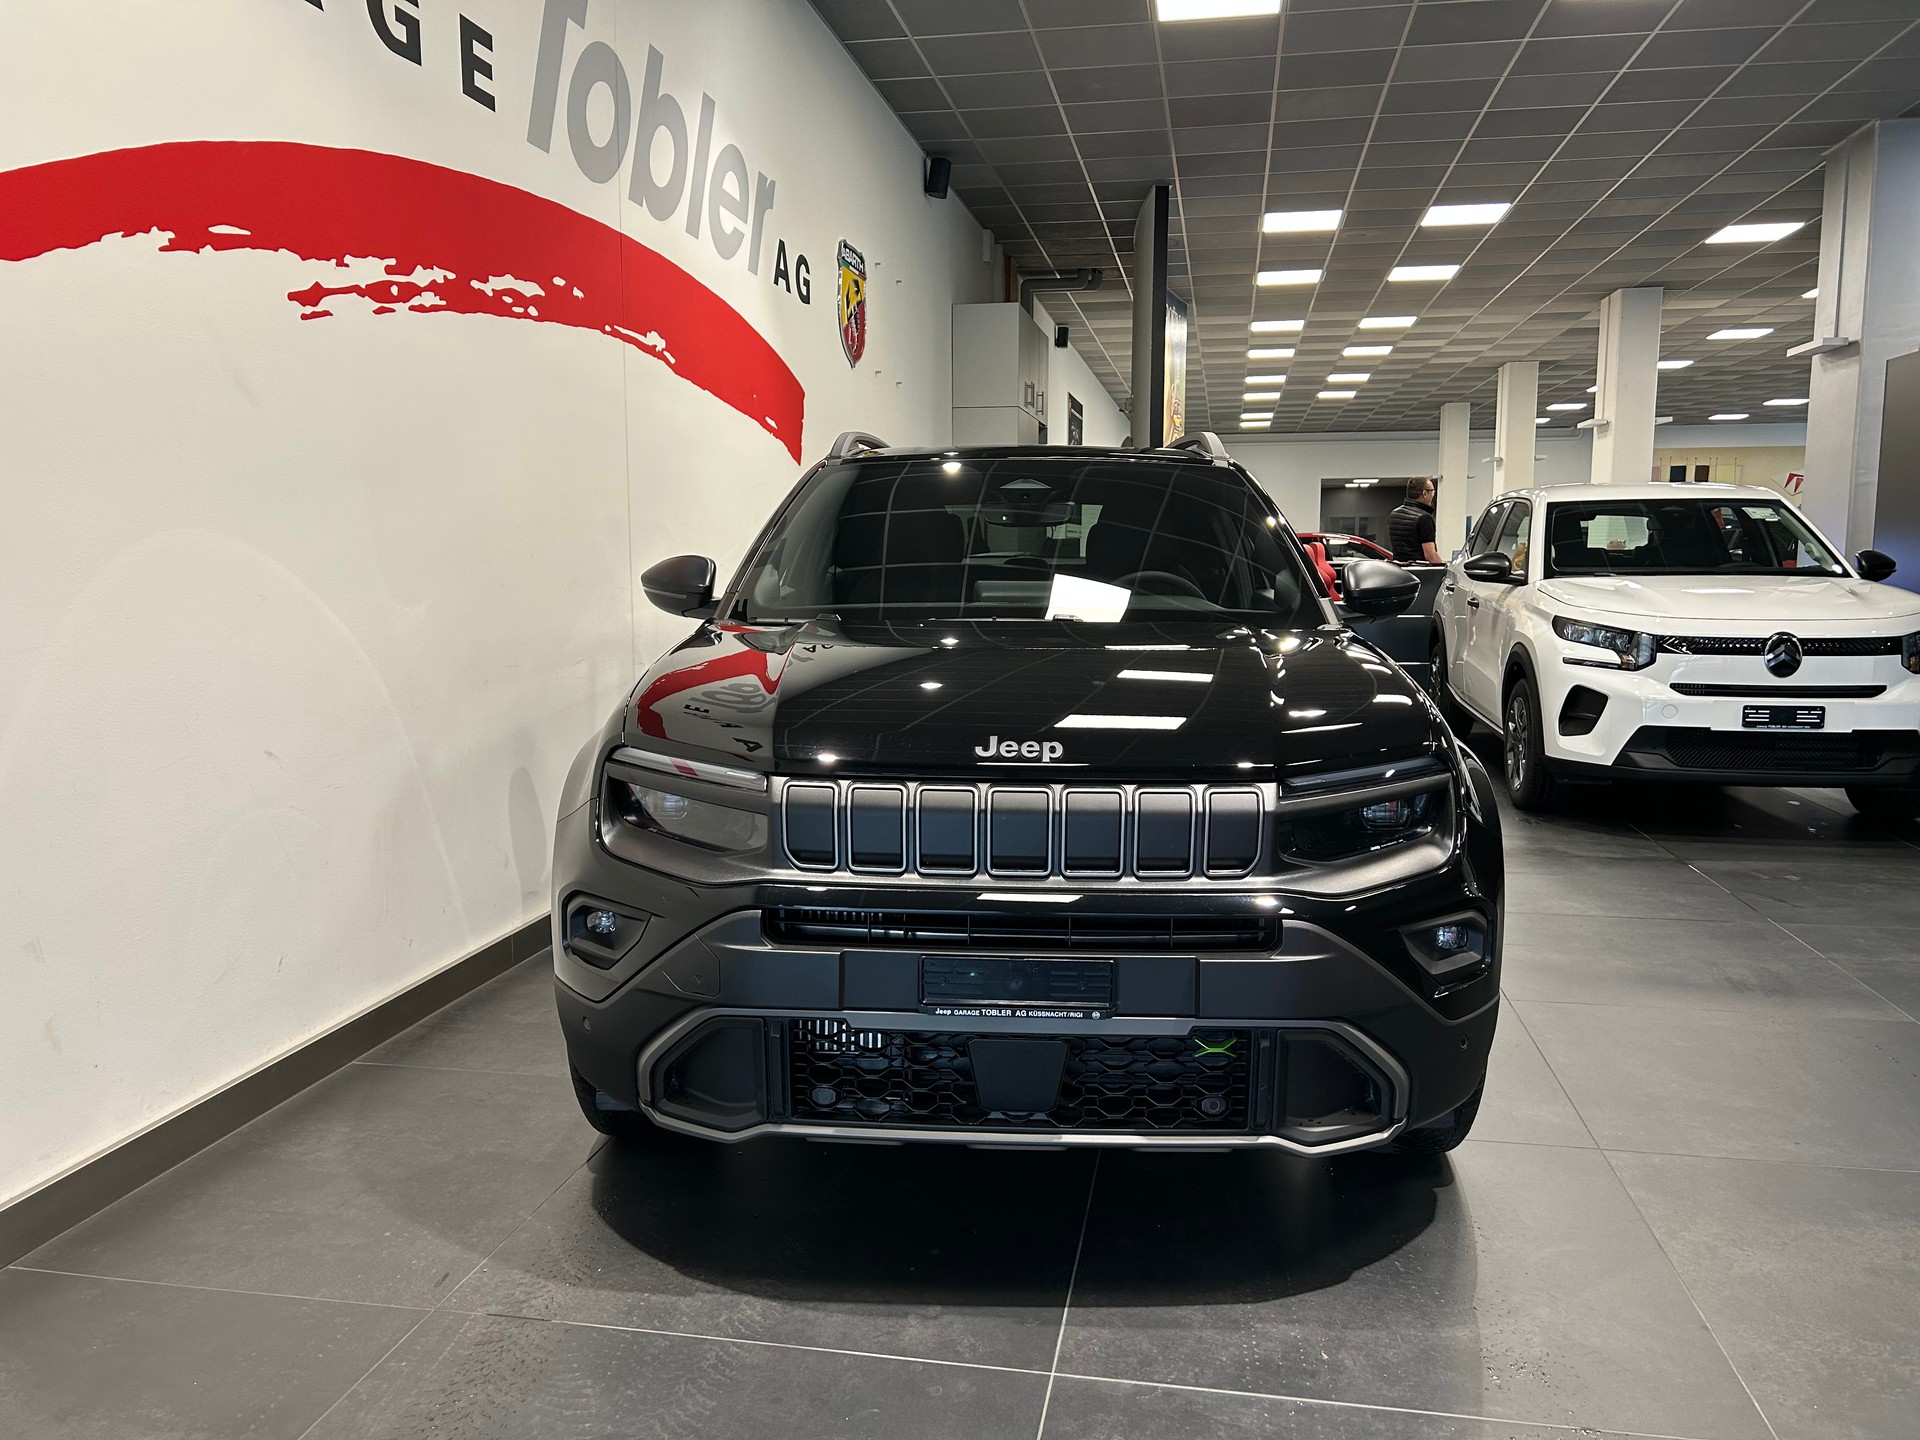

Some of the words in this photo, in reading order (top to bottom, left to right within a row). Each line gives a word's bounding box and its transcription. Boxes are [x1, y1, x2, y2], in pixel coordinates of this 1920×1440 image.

[304, 0, 496, 113] GE
[527, 0, 775, 275] Tobler
[774, 238, 811, 305] AG
[841, 243, 864, 273] ABARTH
[975, 736, 1063, 762] Jeep
[935, 1007, 952, 1016] Jeep
[981, 1009, 1012, 1017] TOBLER
